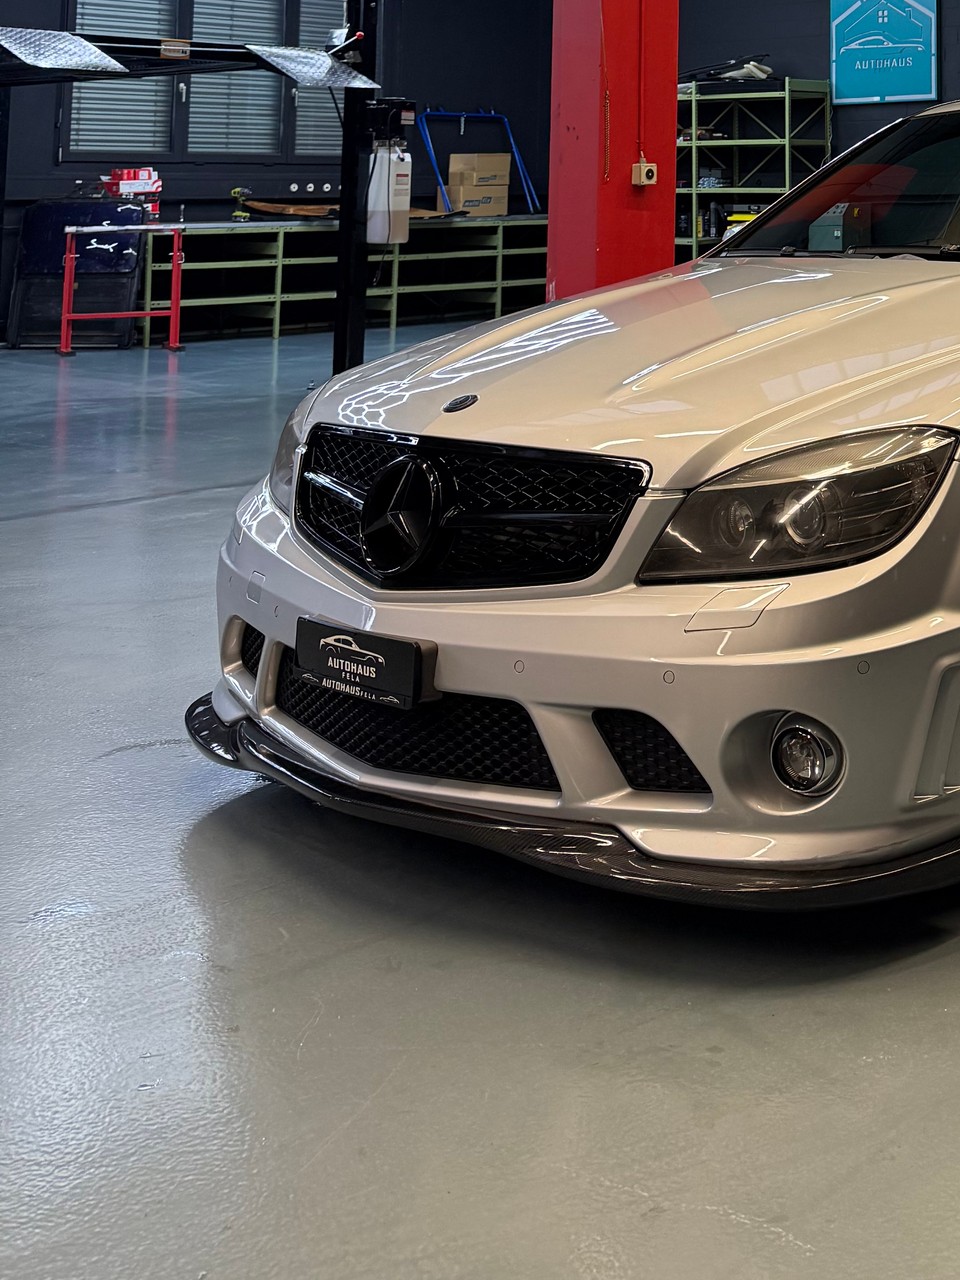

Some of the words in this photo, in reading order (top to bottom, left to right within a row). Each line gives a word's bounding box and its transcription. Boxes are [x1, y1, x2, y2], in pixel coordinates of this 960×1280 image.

[855, 57, 913, 70] AUTOHAUS
[328, 656, 376, 678] AUTOHAUS
[341, 671, 360, 683] FELA
